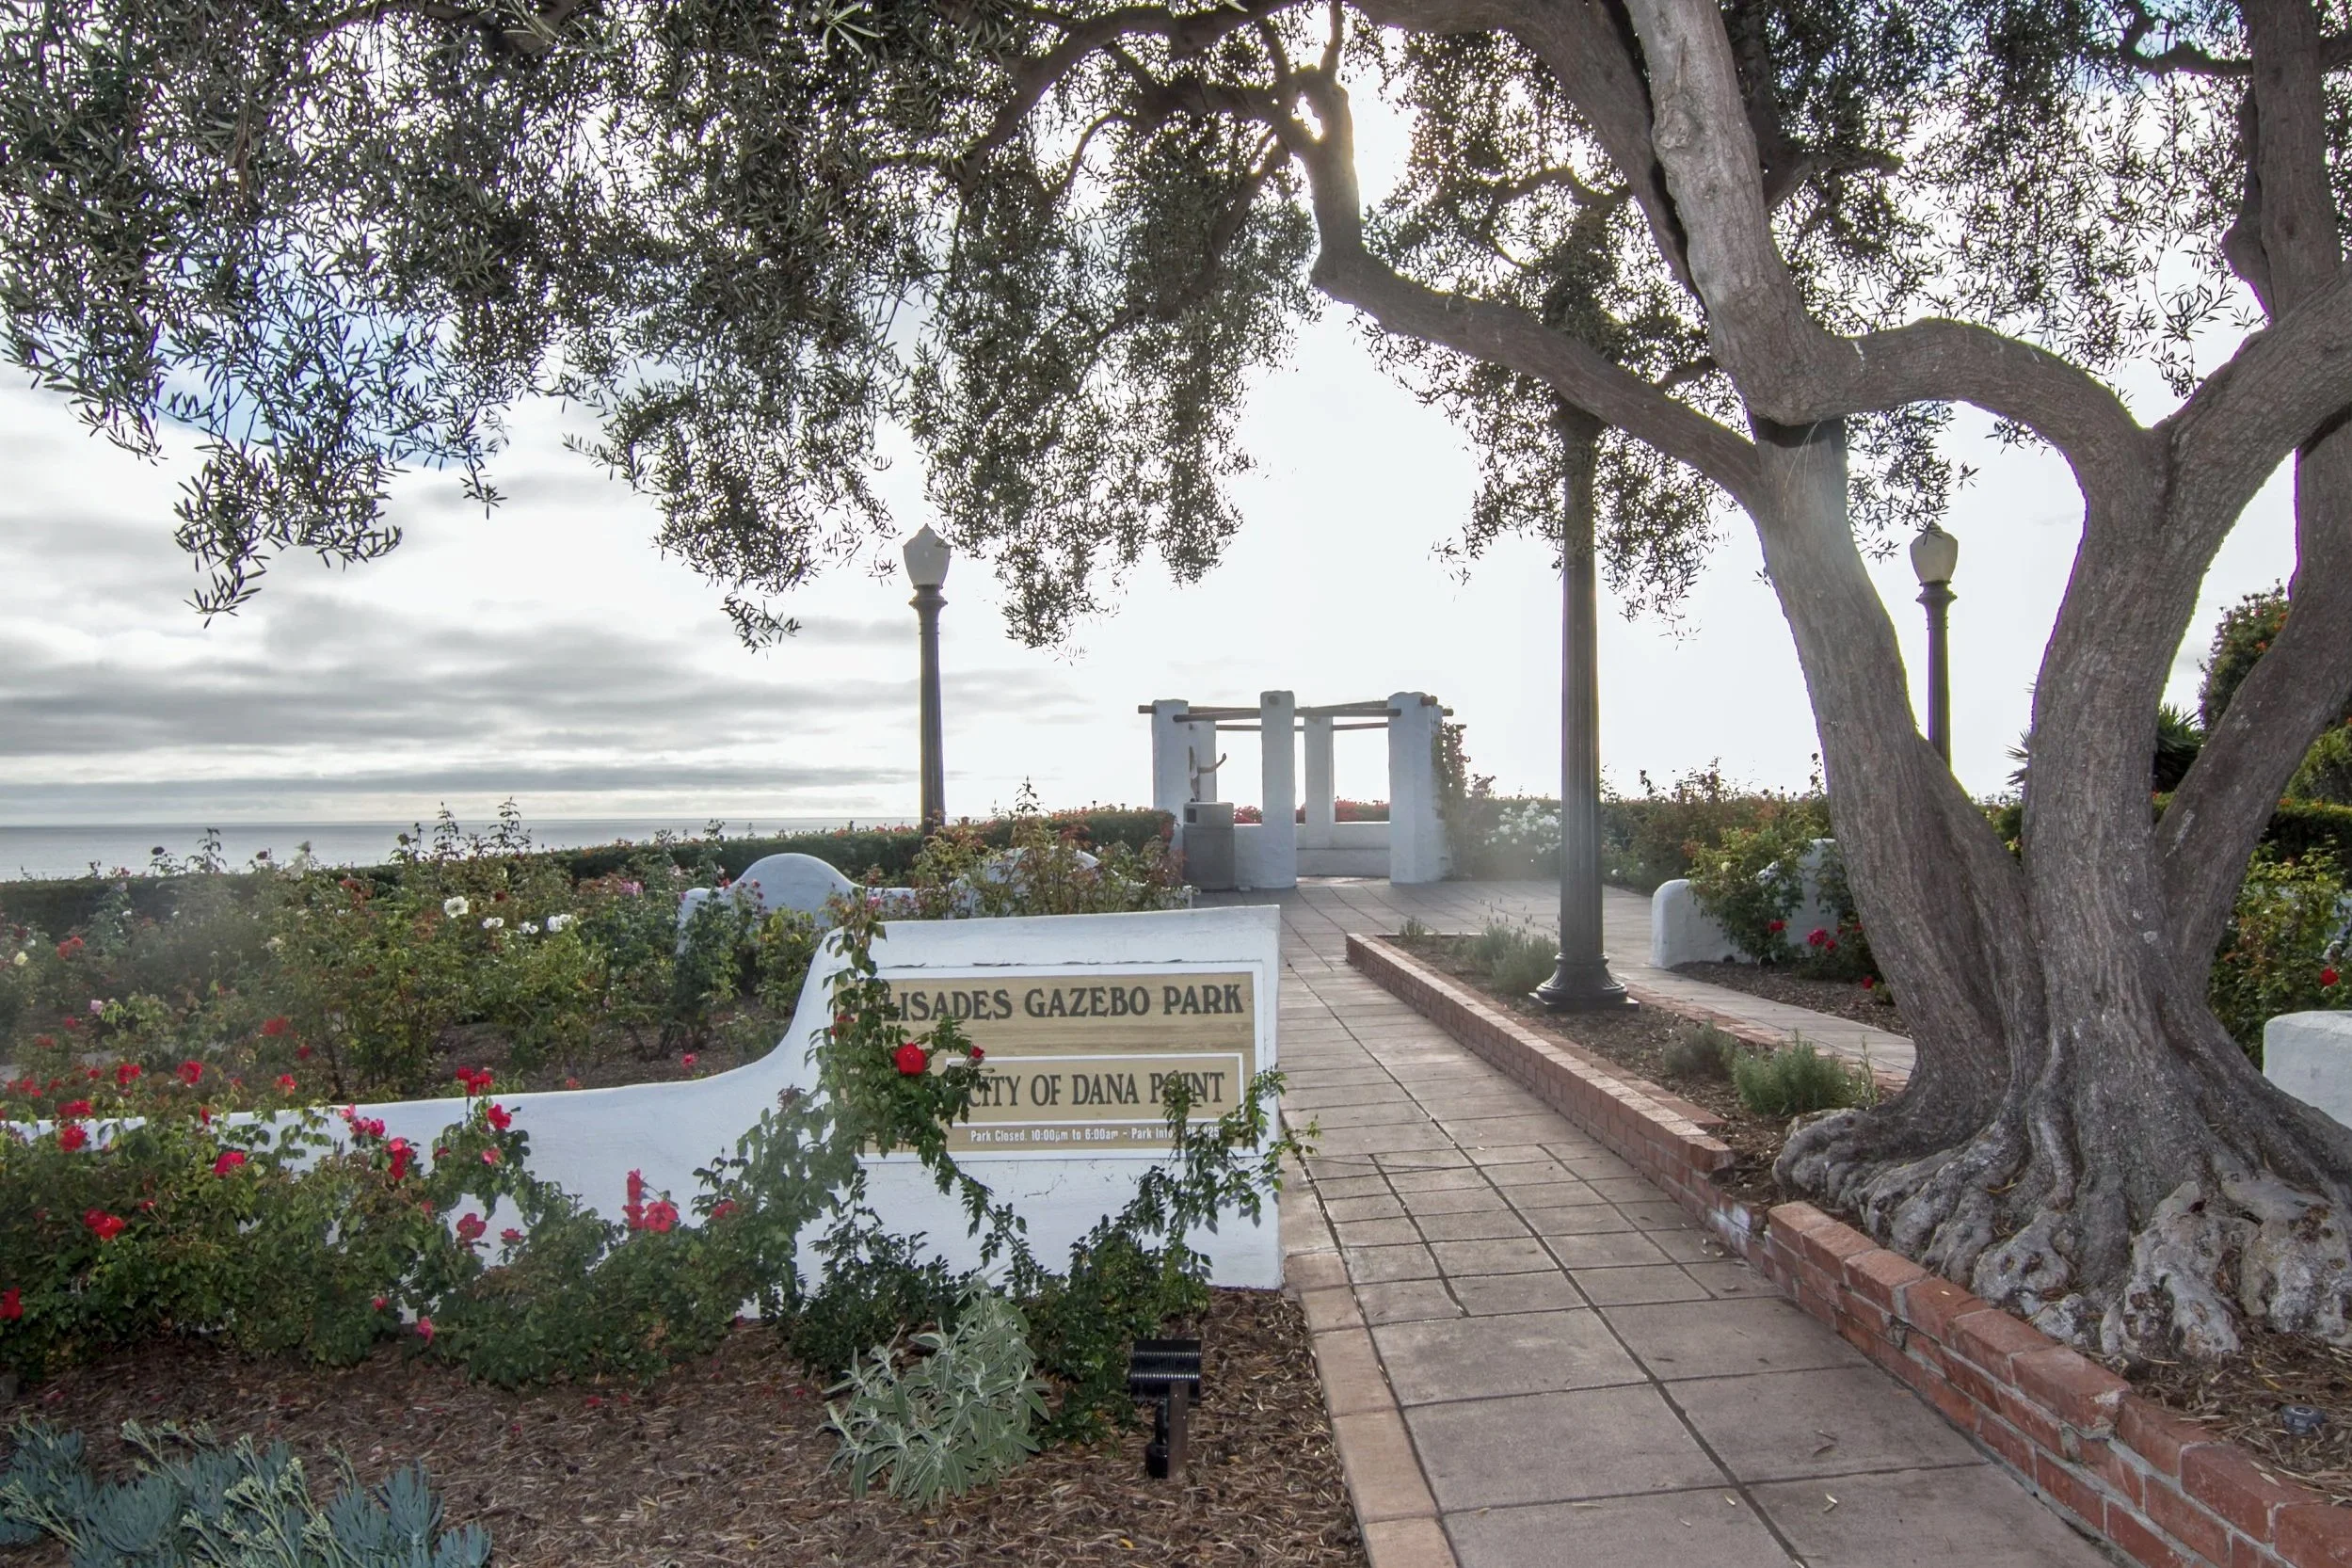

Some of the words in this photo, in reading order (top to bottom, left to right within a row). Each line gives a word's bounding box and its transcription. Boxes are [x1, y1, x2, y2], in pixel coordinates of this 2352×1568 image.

[868, 989, 1012, 1021] LISADES
[1024, 985, 1150, 1017] GAZEBO
[1162, 984, 1244, 1016] PARK
[1031, 1074, 1062, 1107] OF
[1071, 1073, 1140, 1106] DANA
[970, 1129, 992, 1143] Park
[1031, 1128, 1068, 1143] 10:00pm
[1071, 1128, 1081, 1141] to
[1084, 1128, 1119, 1141] 6:00am
[1131, 1128, 1152, 1140] Park
